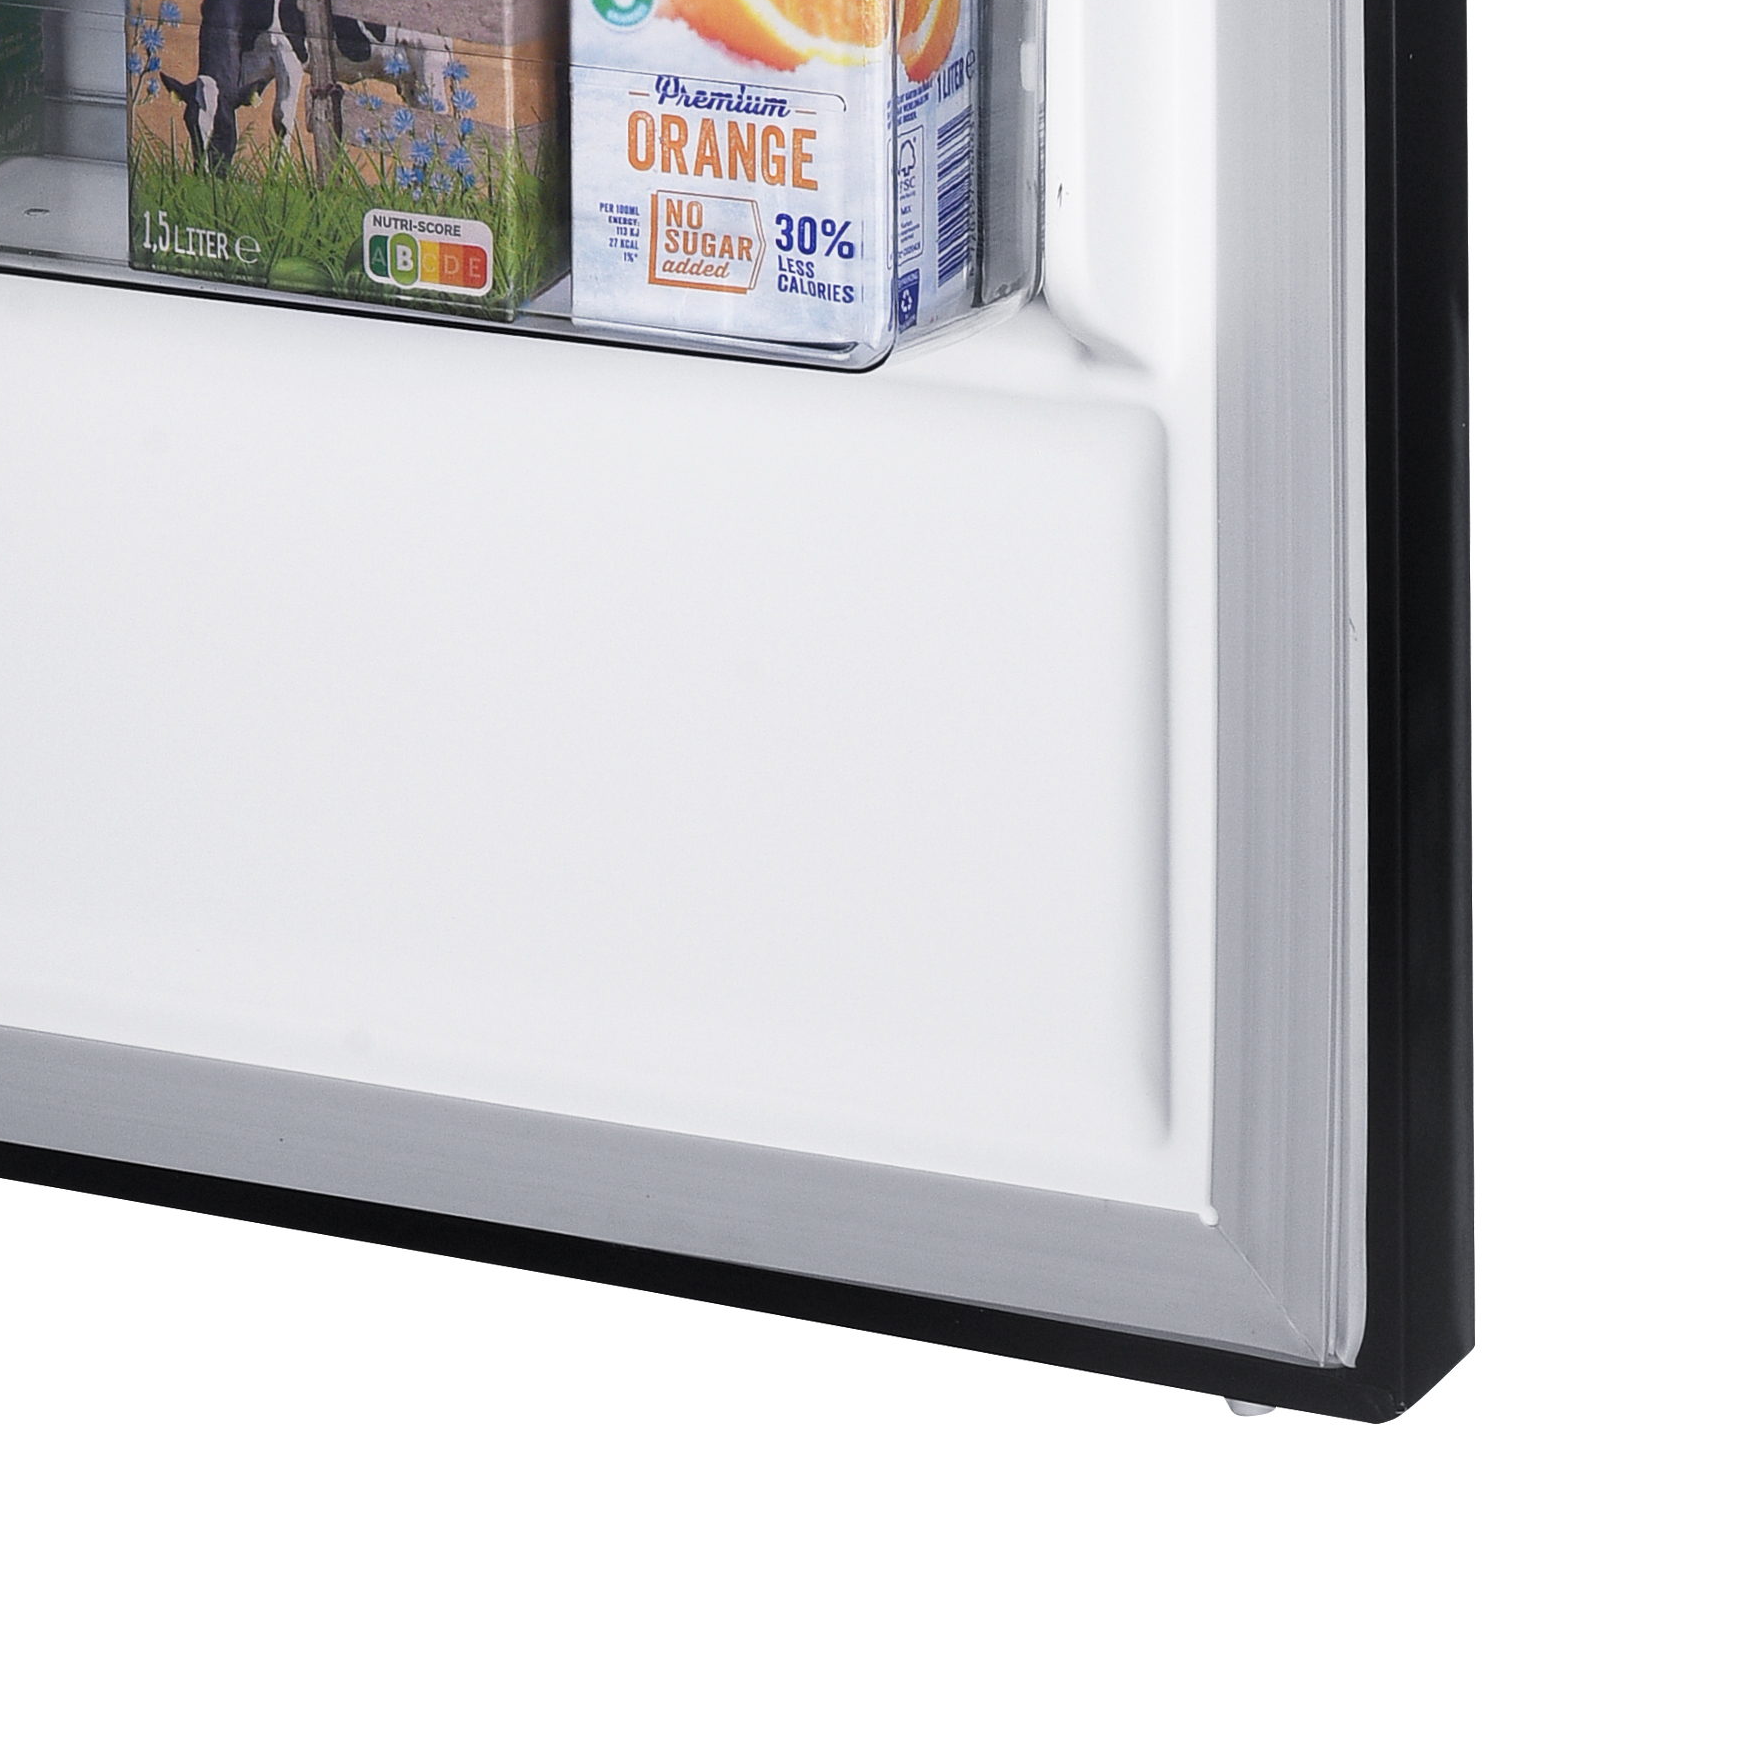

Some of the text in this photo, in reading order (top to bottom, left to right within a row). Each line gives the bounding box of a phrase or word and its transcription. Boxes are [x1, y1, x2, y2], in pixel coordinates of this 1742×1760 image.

[942, 56, 965, 99] LITER
[655, 72, 791, 120] Premium
[627, 110, 818, 192] ORANGE
[599, 202, 640, 216] PER 100ML
[607, 215, 640, 228] ENERGY:
[666, 197, 703, 230] NO
[142, 210, 230, 261] 1,5 LITER
[372, 213, 462, 238] NUTRI-SCORE
[615, 225, 640, 238] 113 KJ
[774, 212, 855, 261] 30%
[608, 236, 640, 250] 27 KCAL
[665, 228, 753, 261] SUGAR
[396, 246, 415, 273] B
[662, 257, 730, 280] added
[778, 256, 816, 279] LESS
[777, 272, 855, 304] CALORIES
